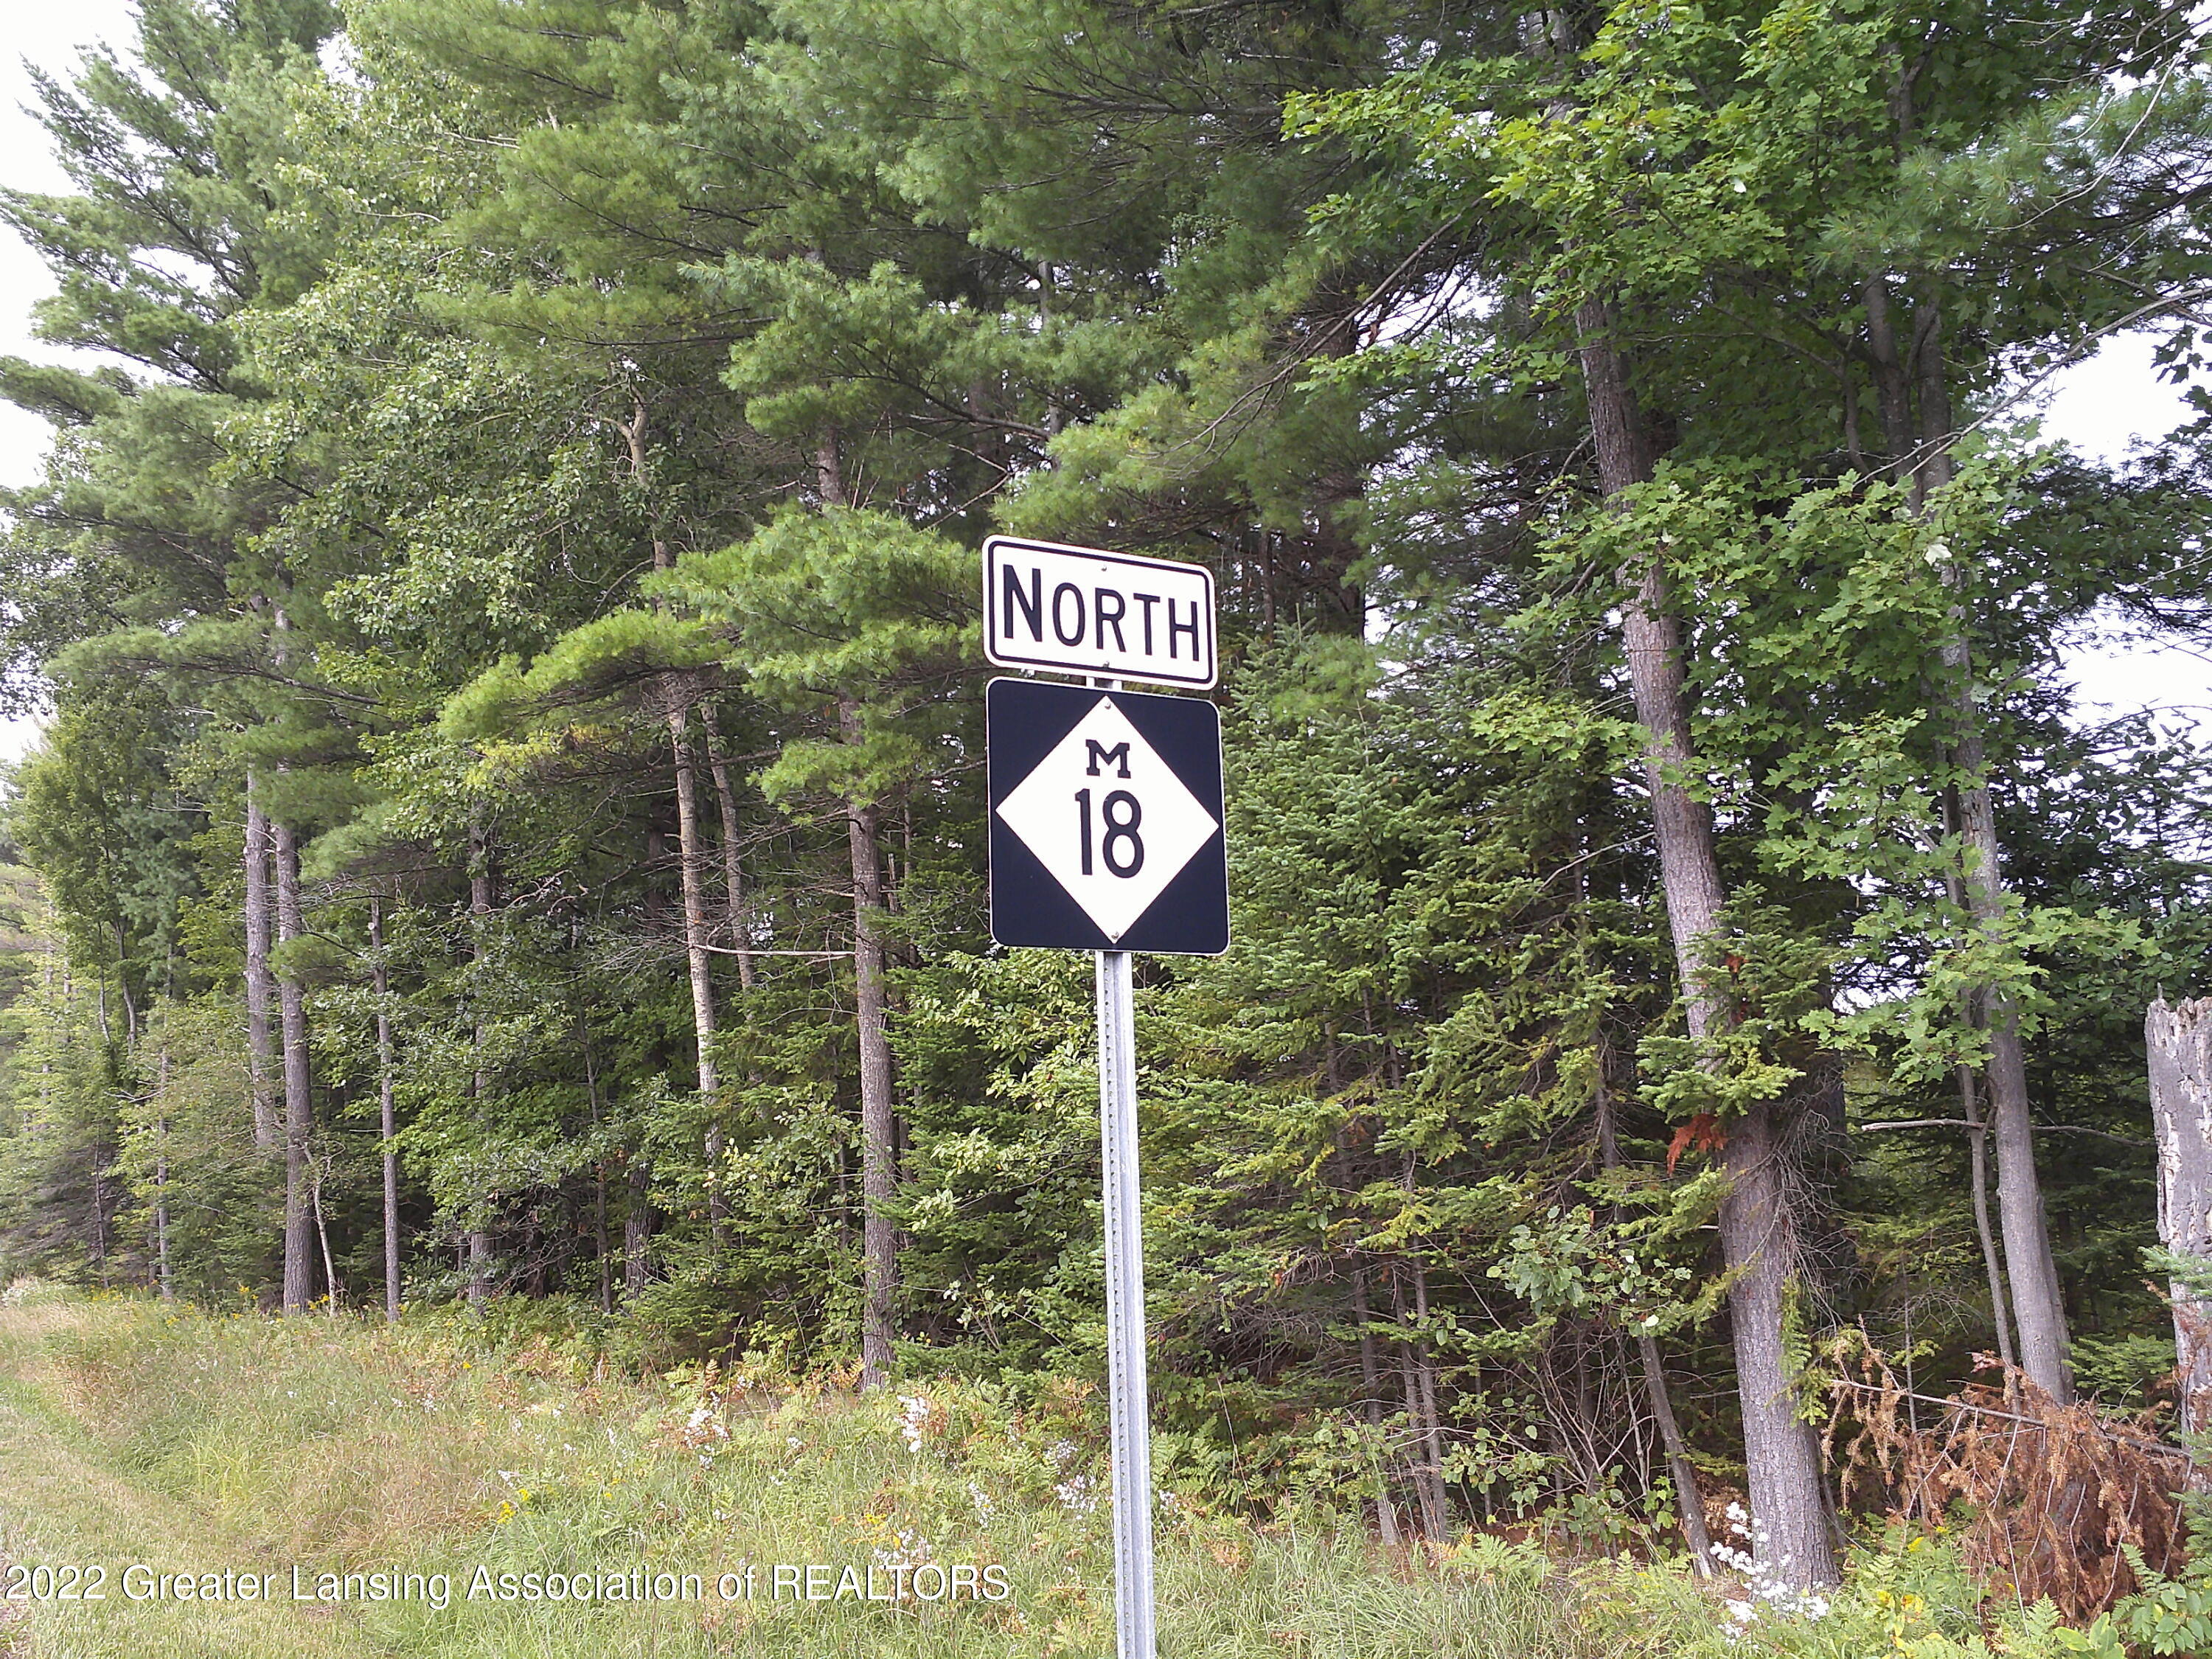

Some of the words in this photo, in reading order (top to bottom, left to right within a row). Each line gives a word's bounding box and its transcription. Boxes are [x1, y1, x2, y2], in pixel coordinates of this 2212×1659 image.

[1003, 564, 1200, 661] NORTH
[1086, 740, 1131, 779] M
[1075, 788, 1144, 878] 18
